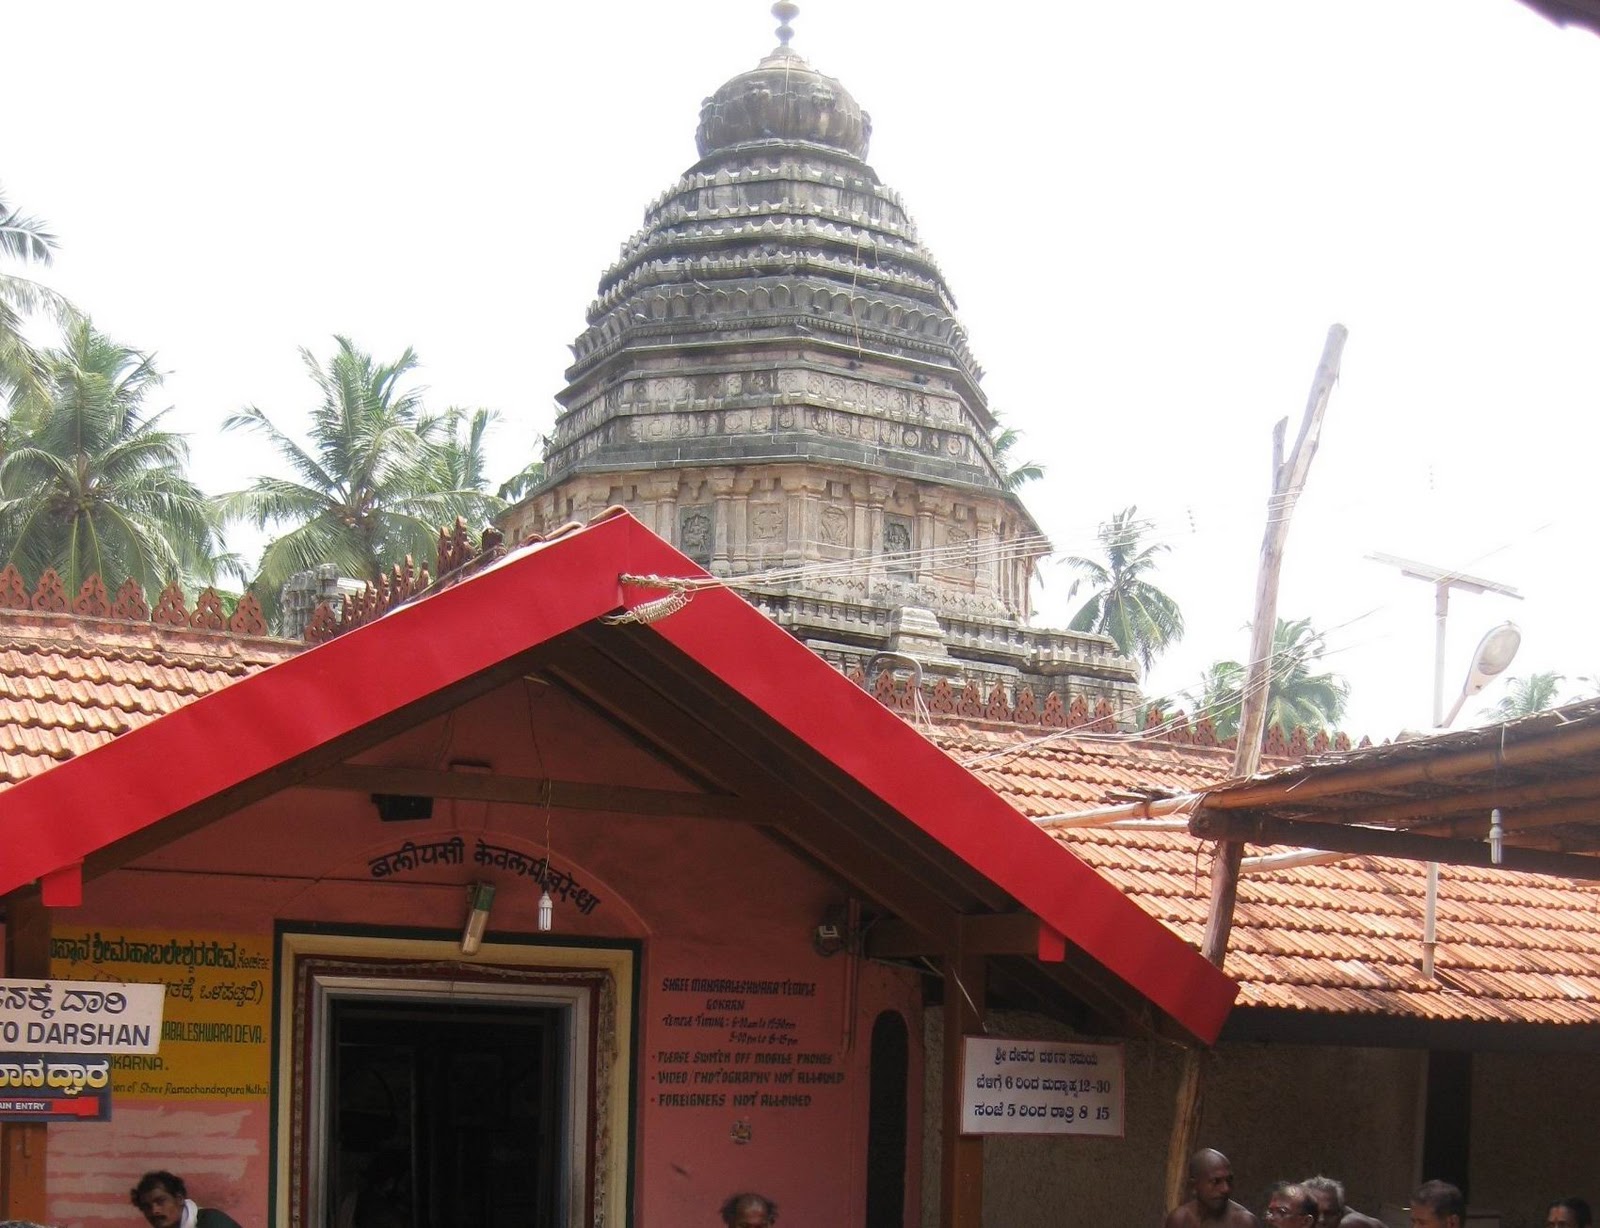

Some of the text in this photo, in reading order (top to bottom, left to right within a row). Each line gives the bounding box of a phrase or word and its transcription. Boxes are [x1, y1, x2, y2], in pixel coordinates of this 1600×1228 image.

[61, 989, 127, 1014] ದಾರಿ
[27, 1022, 150, 1047] DARSHAN
[1005, 1076, 1013, 1089] 6
[1015, 1077, 1039, 1090] ರಿಂದ
[1079, 1079, 1111, 1094] 12-30
[15, 1102, 46, 1111] ENTRY
[659, 1091, 812, 1107] FOREIGNERS NOT ALLOWED
[974, 1102, 1004, 1116] ಸಂಜೆ
[1007, 1103, 1016, 1116] 5
[1019, 1104, 1047, 1117] ರಿಂದ
[1079, 1105, 1088, 1119] 8
[1096, 1106, 1110, 1120] 15
